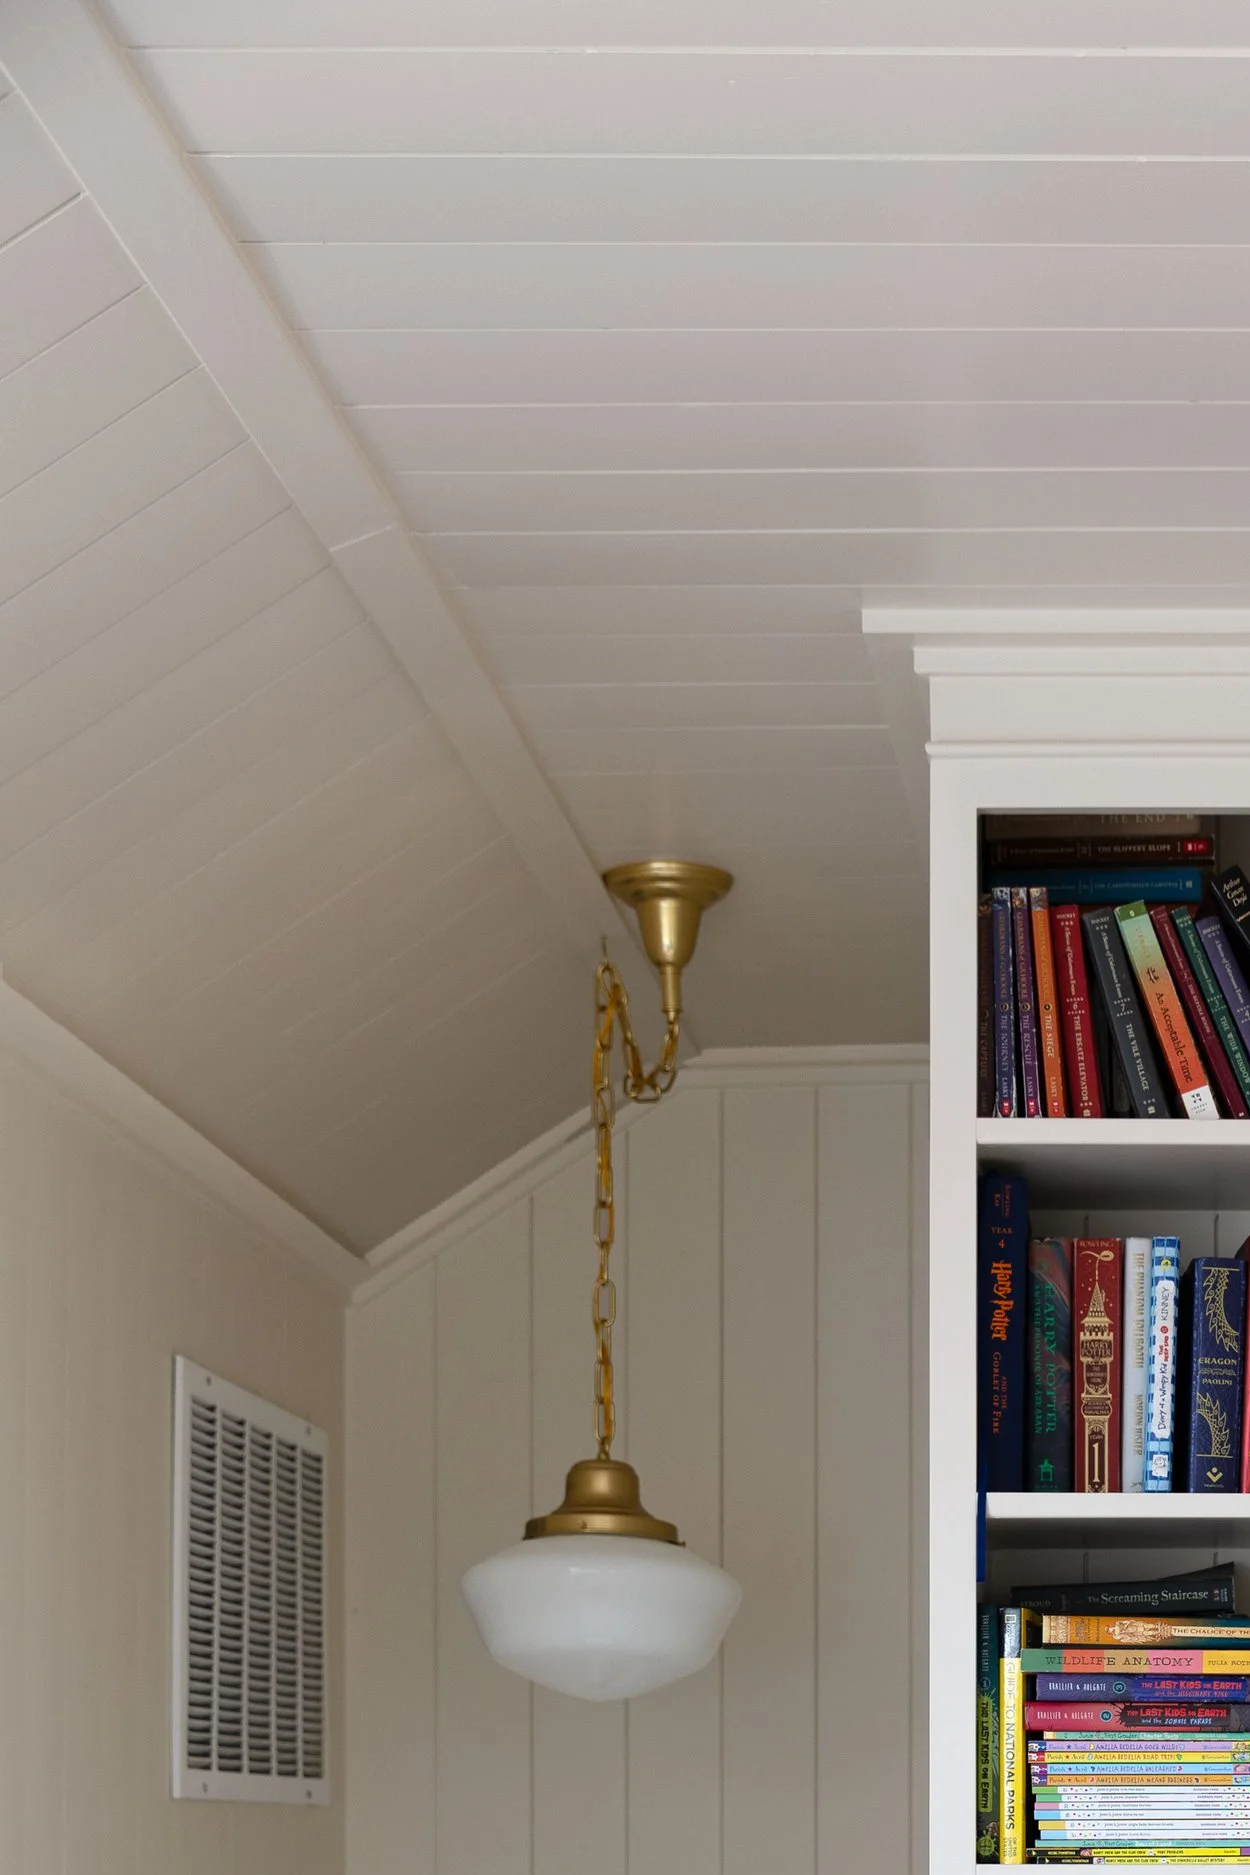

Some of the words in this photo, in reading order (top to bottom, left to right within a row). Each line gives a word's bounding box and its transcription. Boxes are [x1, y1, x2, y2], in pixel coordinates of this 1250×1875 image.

[1073, 1015, 1081, 1030] THE
[1125, 1023, 1135, 1038] THE
[1155, 991, 1165, 1005] An
[1160, 1006, 1185, 1057] Acceptable
[1178, 1057, 1193, 1083] Time
[1075, 1032, 1084, 1061] ERSATZ
[1128, 1039, 1140, 1057] VILE
[1077, 1062, 1088, 1101] ELEVATOR
[1134, 1058, 1149, 1091] VILLAGE
[990, 1226, 1013, 1234] YEAR
[998, 1239, 1005, 1248] 4
[991, 1260, 1013, 1298] Harry
[991, 1298, 1014, 1342] Potter
[1081, 1348, 1111, 1357] POTTER
[1084, 1341, 1109, 1349] HARRY
[1199, 1356, 1237, 1366] ERAGON
[1202, 1378, 1233, 1386] PAOLINI
[1101, 1591, 1159, 1606] Screaming
[1161, 1590, 1209, 1601] Staircase
[1045, 1657, 1115, 1666] WILDLIFE
[1123, 1657, 1194, 1667] ANATOMY
